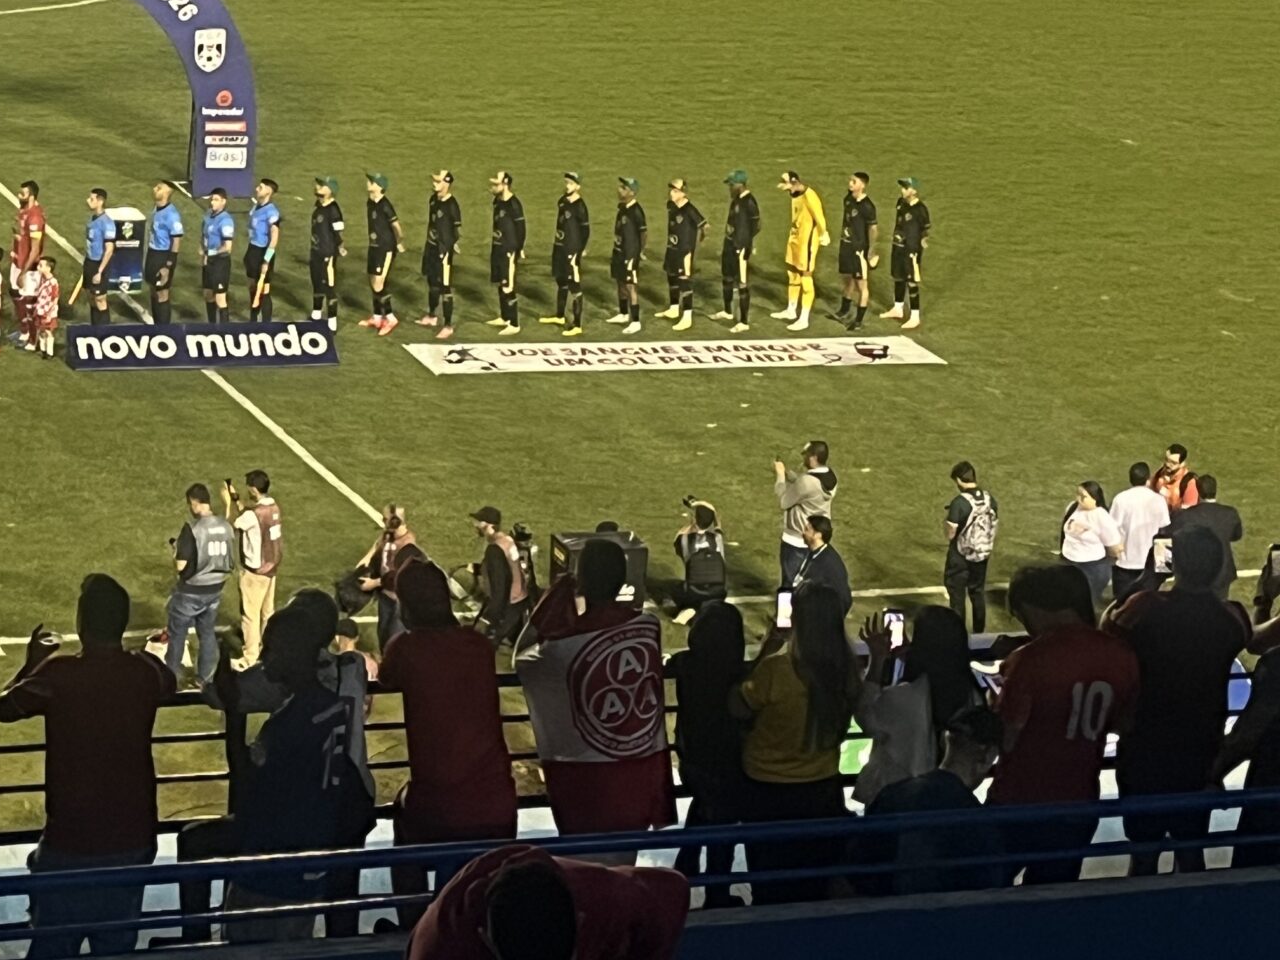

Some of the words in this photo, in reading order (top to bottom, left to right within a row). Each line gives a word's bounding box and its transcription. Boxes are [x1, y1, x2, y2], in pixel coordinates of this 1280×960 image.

[76, 334, 178, 360] novo
[186, 323, 328, 358] mundo
[1066, 680, 1114, 741] 10
